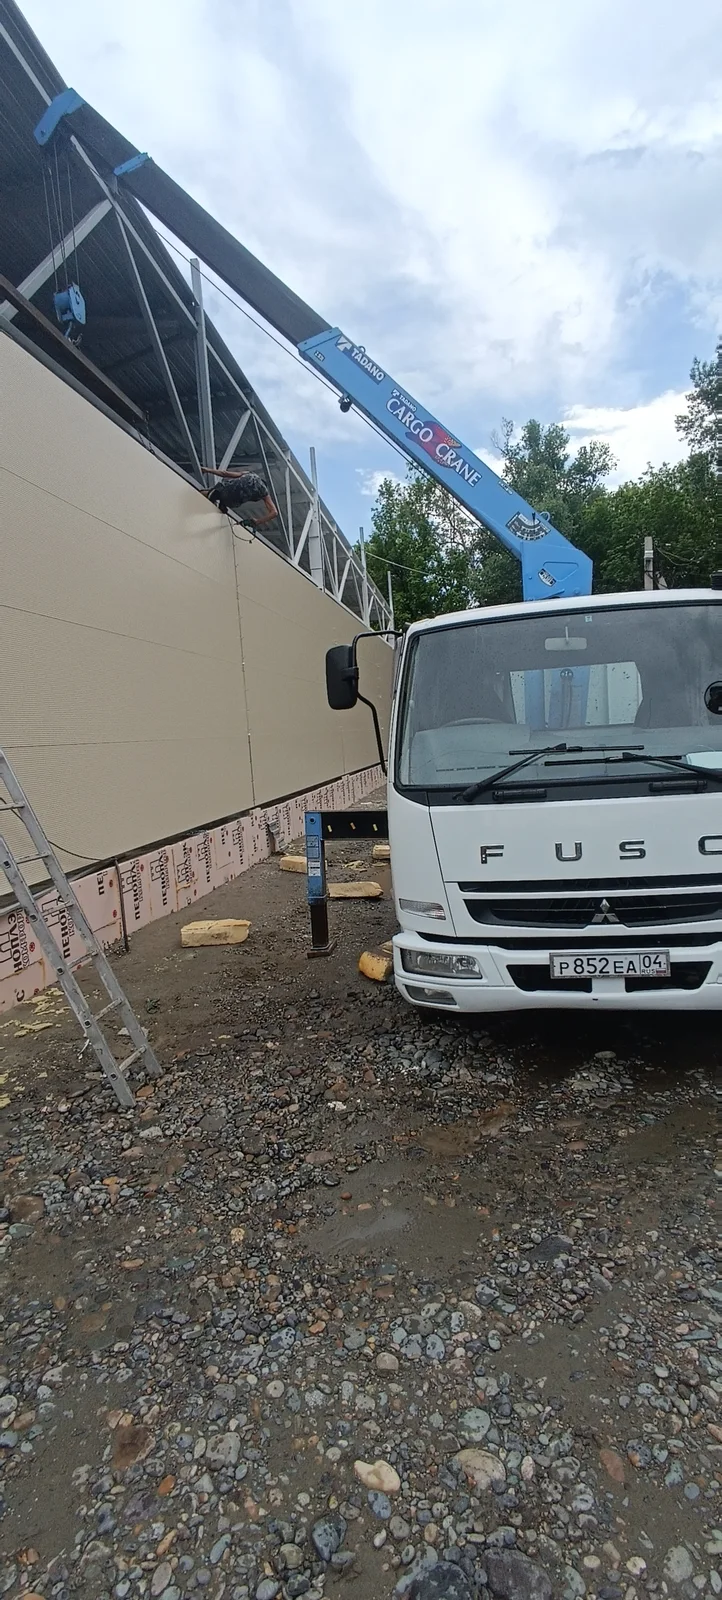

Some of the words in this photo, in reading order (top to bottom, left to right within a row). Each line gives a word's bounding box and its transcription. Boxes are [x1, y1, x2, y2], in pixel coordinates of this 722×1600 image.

[351, 347, 385, 382] TADANO
[399, 394, 417, 412] TADANO
[386, 397, 434, 443] CARGO
[435, 443, 482, 487] CRANE
[642, 955, 662, 969] 04
